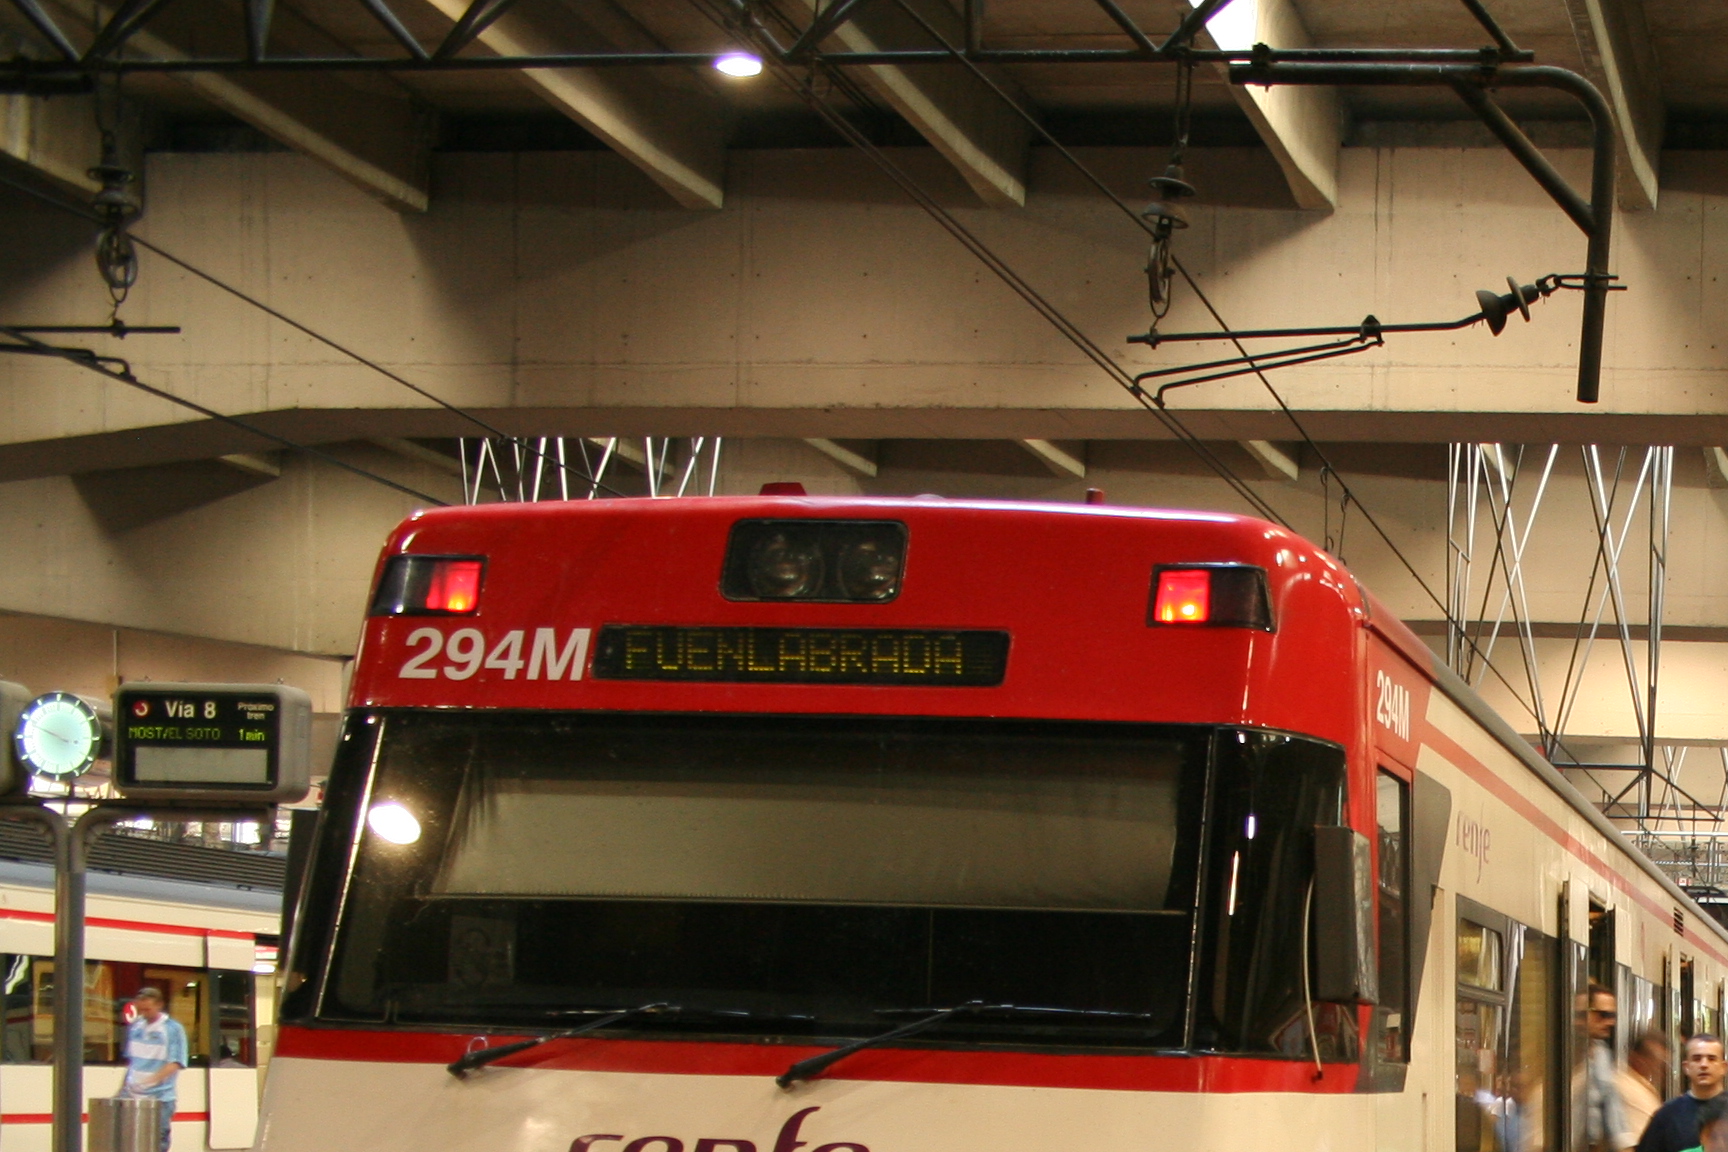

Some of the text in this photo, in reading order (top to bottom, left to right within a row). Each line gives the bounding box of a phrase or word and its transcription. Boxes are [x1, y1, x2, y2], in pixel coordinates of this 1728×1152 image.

[399, 627, 592, 682] 294M
[625, 630, 963, 675] FUENLABRADA
[204, 702, 216, 719] 8
[1376, 669, 1410, 743] 294M
[185, 728, 221, 740] SOTO
